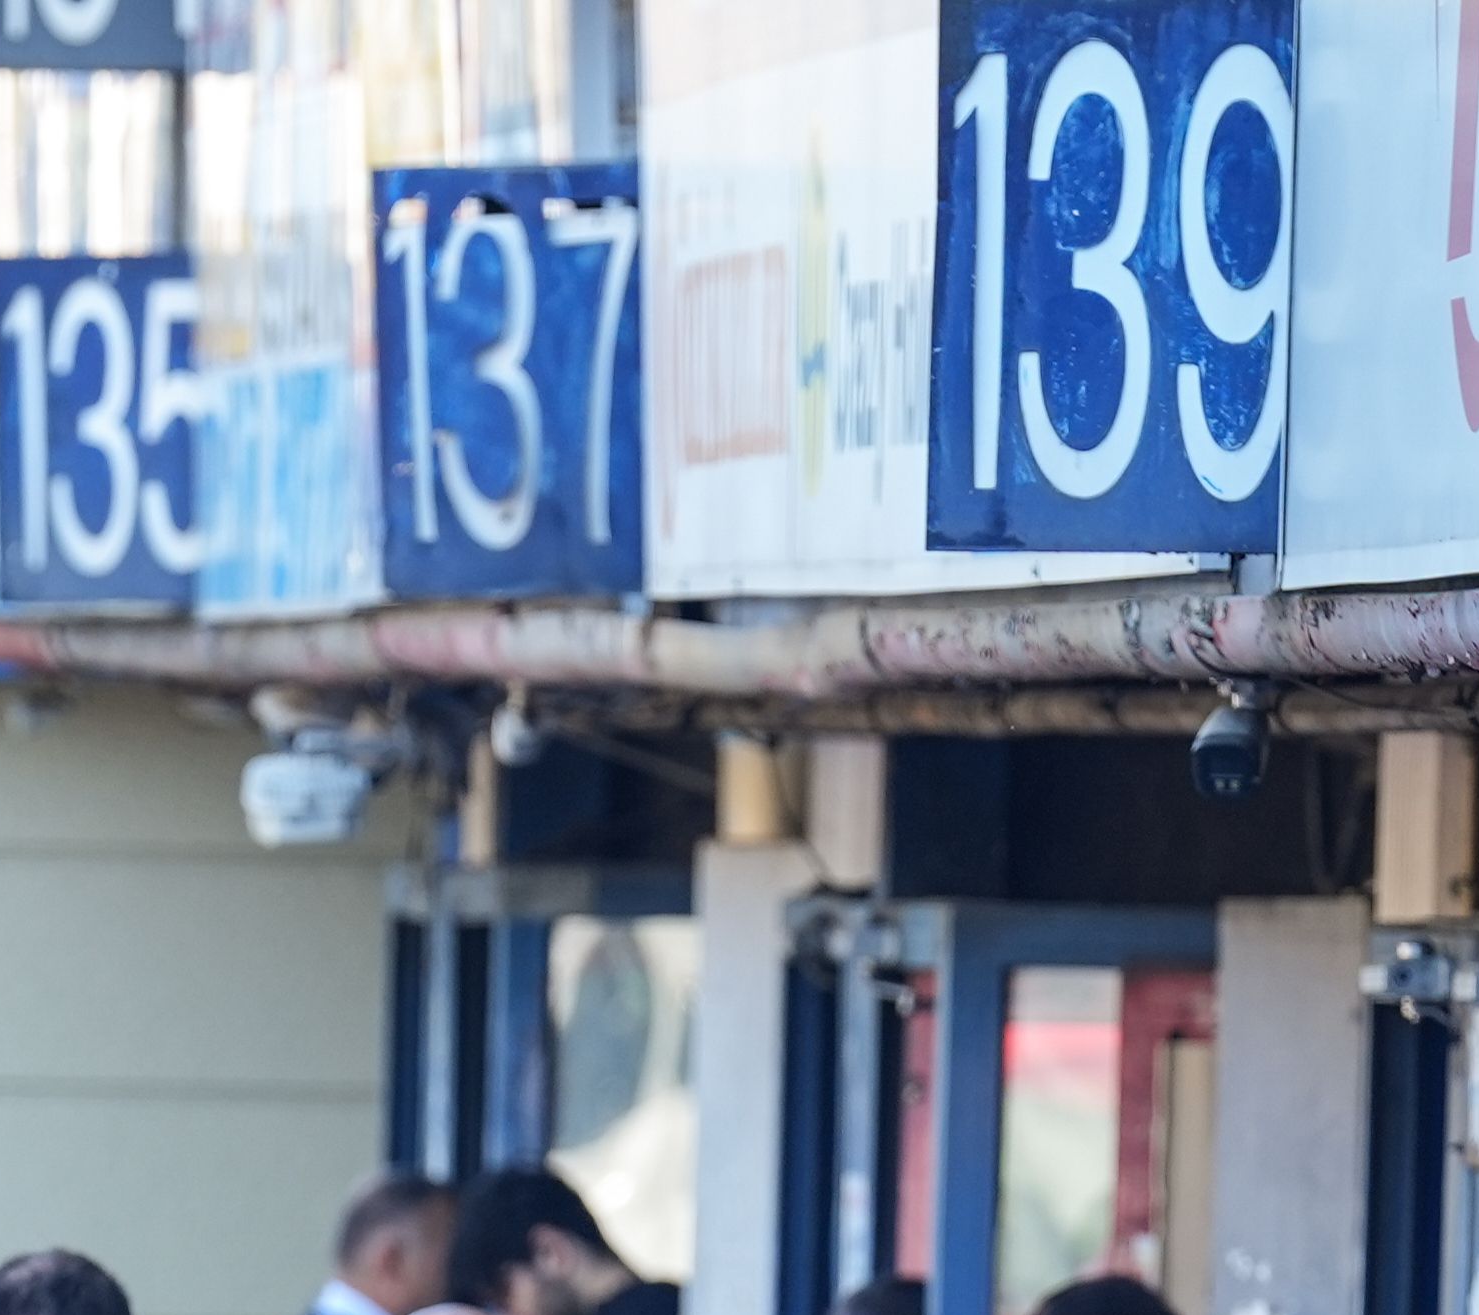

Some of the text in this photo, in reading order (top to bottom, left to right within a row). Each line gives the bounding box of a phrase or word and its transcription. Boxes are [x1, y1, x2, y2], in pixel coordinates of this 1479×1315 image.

[0, 277, 205, 578] 135
[384, 207, 639, 551] 137
[952, 37, 1295, 502] 139
